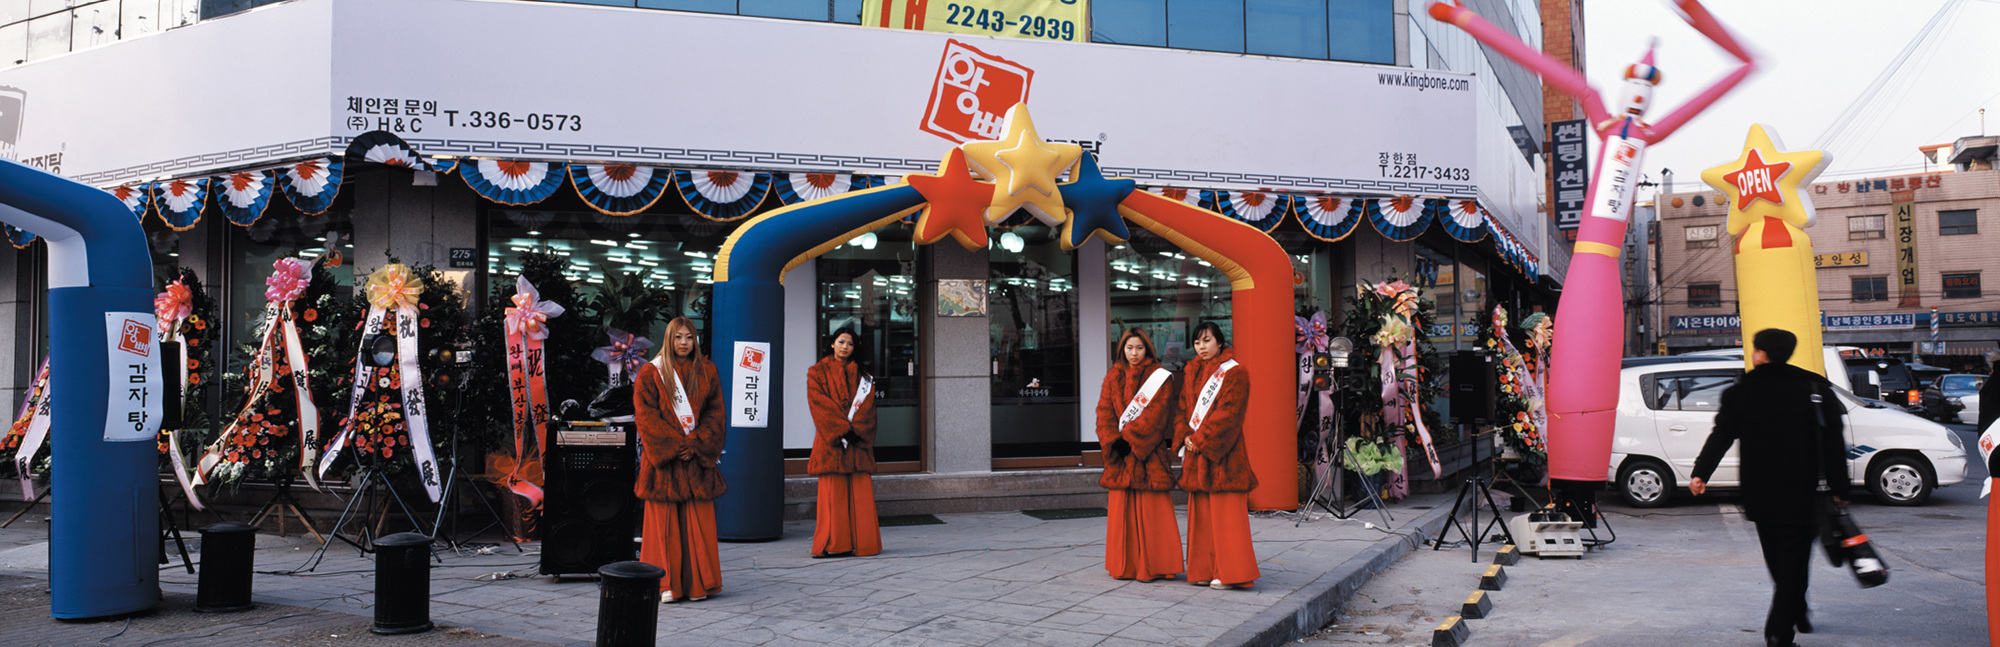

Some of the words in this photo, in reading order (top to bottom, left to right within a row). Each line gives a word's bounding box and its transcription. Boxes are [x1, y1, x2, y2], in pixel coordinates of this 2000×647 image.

[946, 4, 1075, 41] 2243-2939
[1378, 72, 1469, 91] www.kingbone.com
[347, 96, 399, 115] 체인점
[404, 99, 438, 117] 문의
[346, 116, 369, 131] (주)
[444, 110, 582, 131] T.336-0573
[1379, 165, 1470, 181] T.2217-3433
[1737, 168, 1773, 197] OPEN
[452, 250, 471, 259] 275
[1897, 204, 1915, 285] 신장개업
[128, 363, 148, 431] 감자탕
[744, 375, 759, 421] 감자탕
